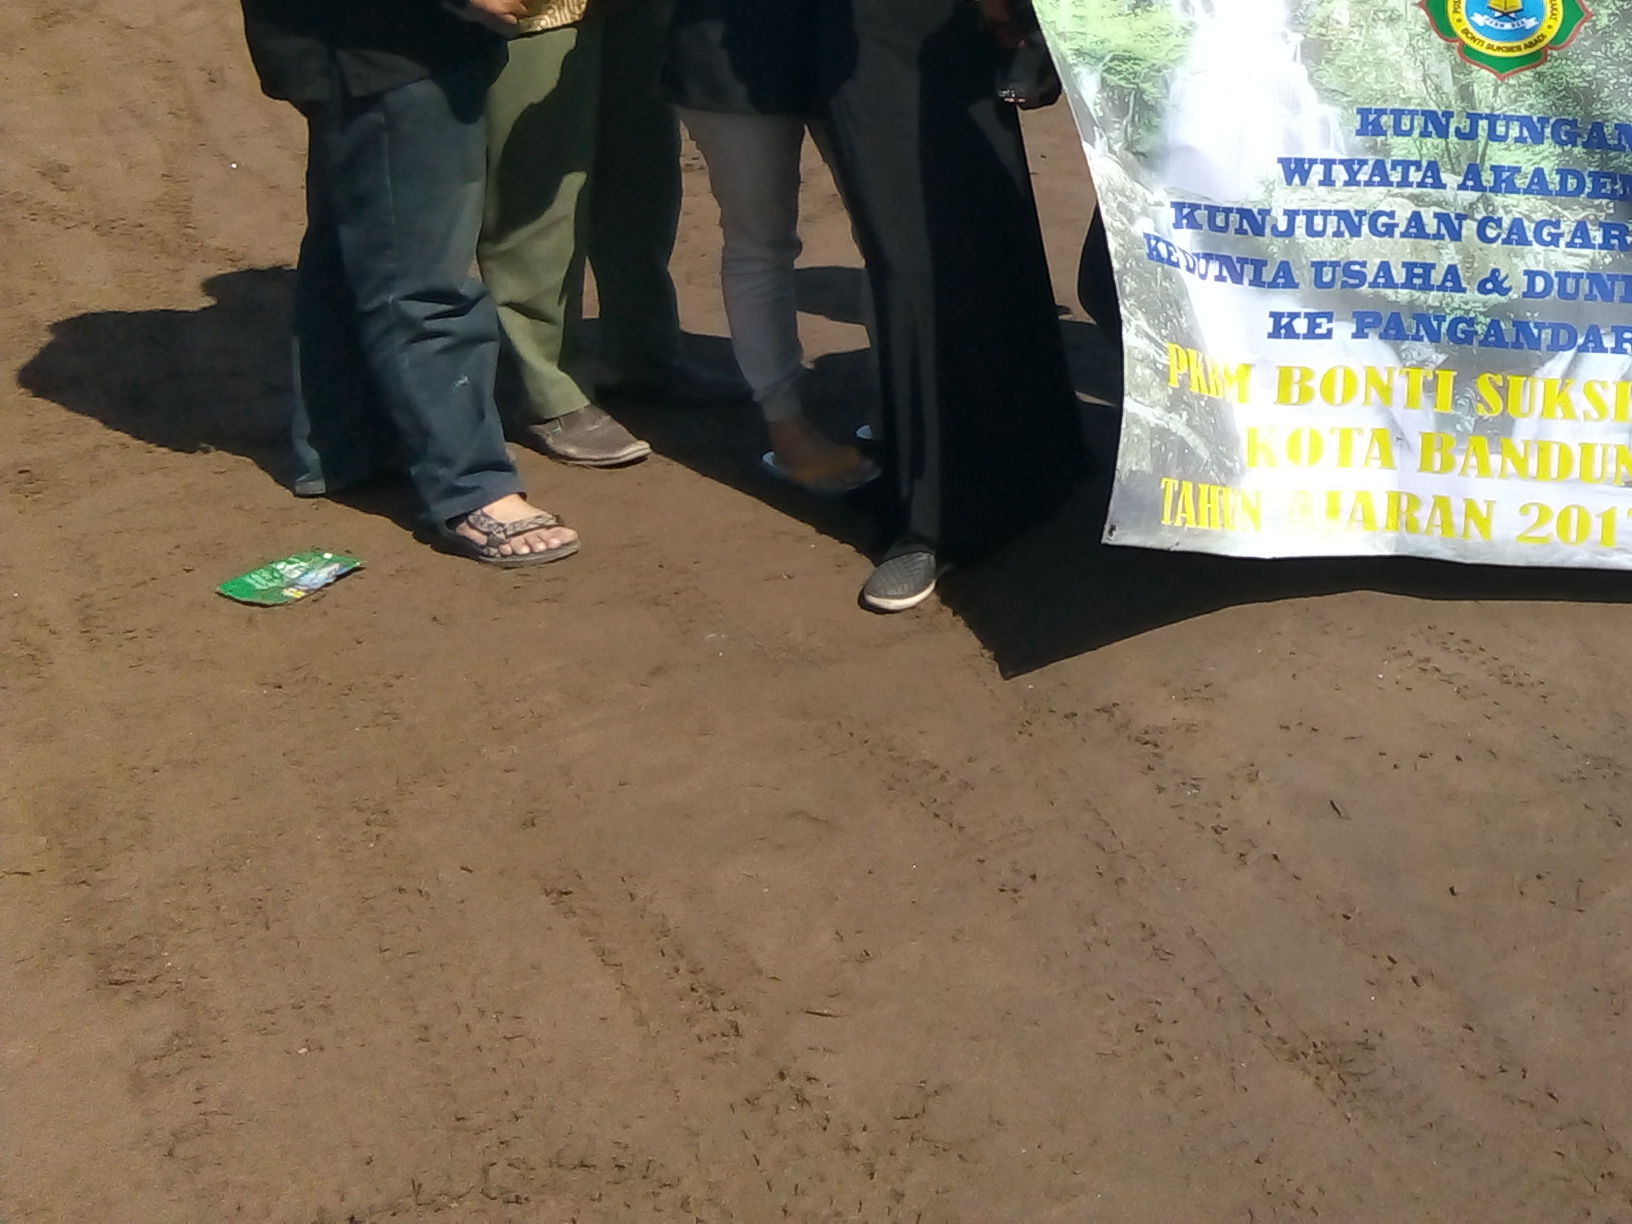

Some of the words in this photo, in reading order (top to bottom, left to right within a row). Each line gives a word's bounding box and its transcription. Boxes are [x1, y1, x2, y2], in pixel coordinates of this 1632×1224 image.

[1460, 27, 1486, 49] BONTI
[1484, 42, 1523, 53] SUKSES
[1523, 32, 1548, 52] ABADI
[1277, 156, 1446, 189] WIYATA
[1170, 201, 1467, 242] KUNJUNGAN
[1476, 215, 1631, 252] CAGAR
[1144, 232, 1180, 268] KE
[1178, 247, 1299, 290] DUNIA
[1310, 260, 1467, 294] USAHA
[1477, 268, 1513, 297] &
[1267, 310, 1334, 340] KE
[1274, 365, 1458, 414] BONTI
[1245, 426, 1397, 472] KOTA
